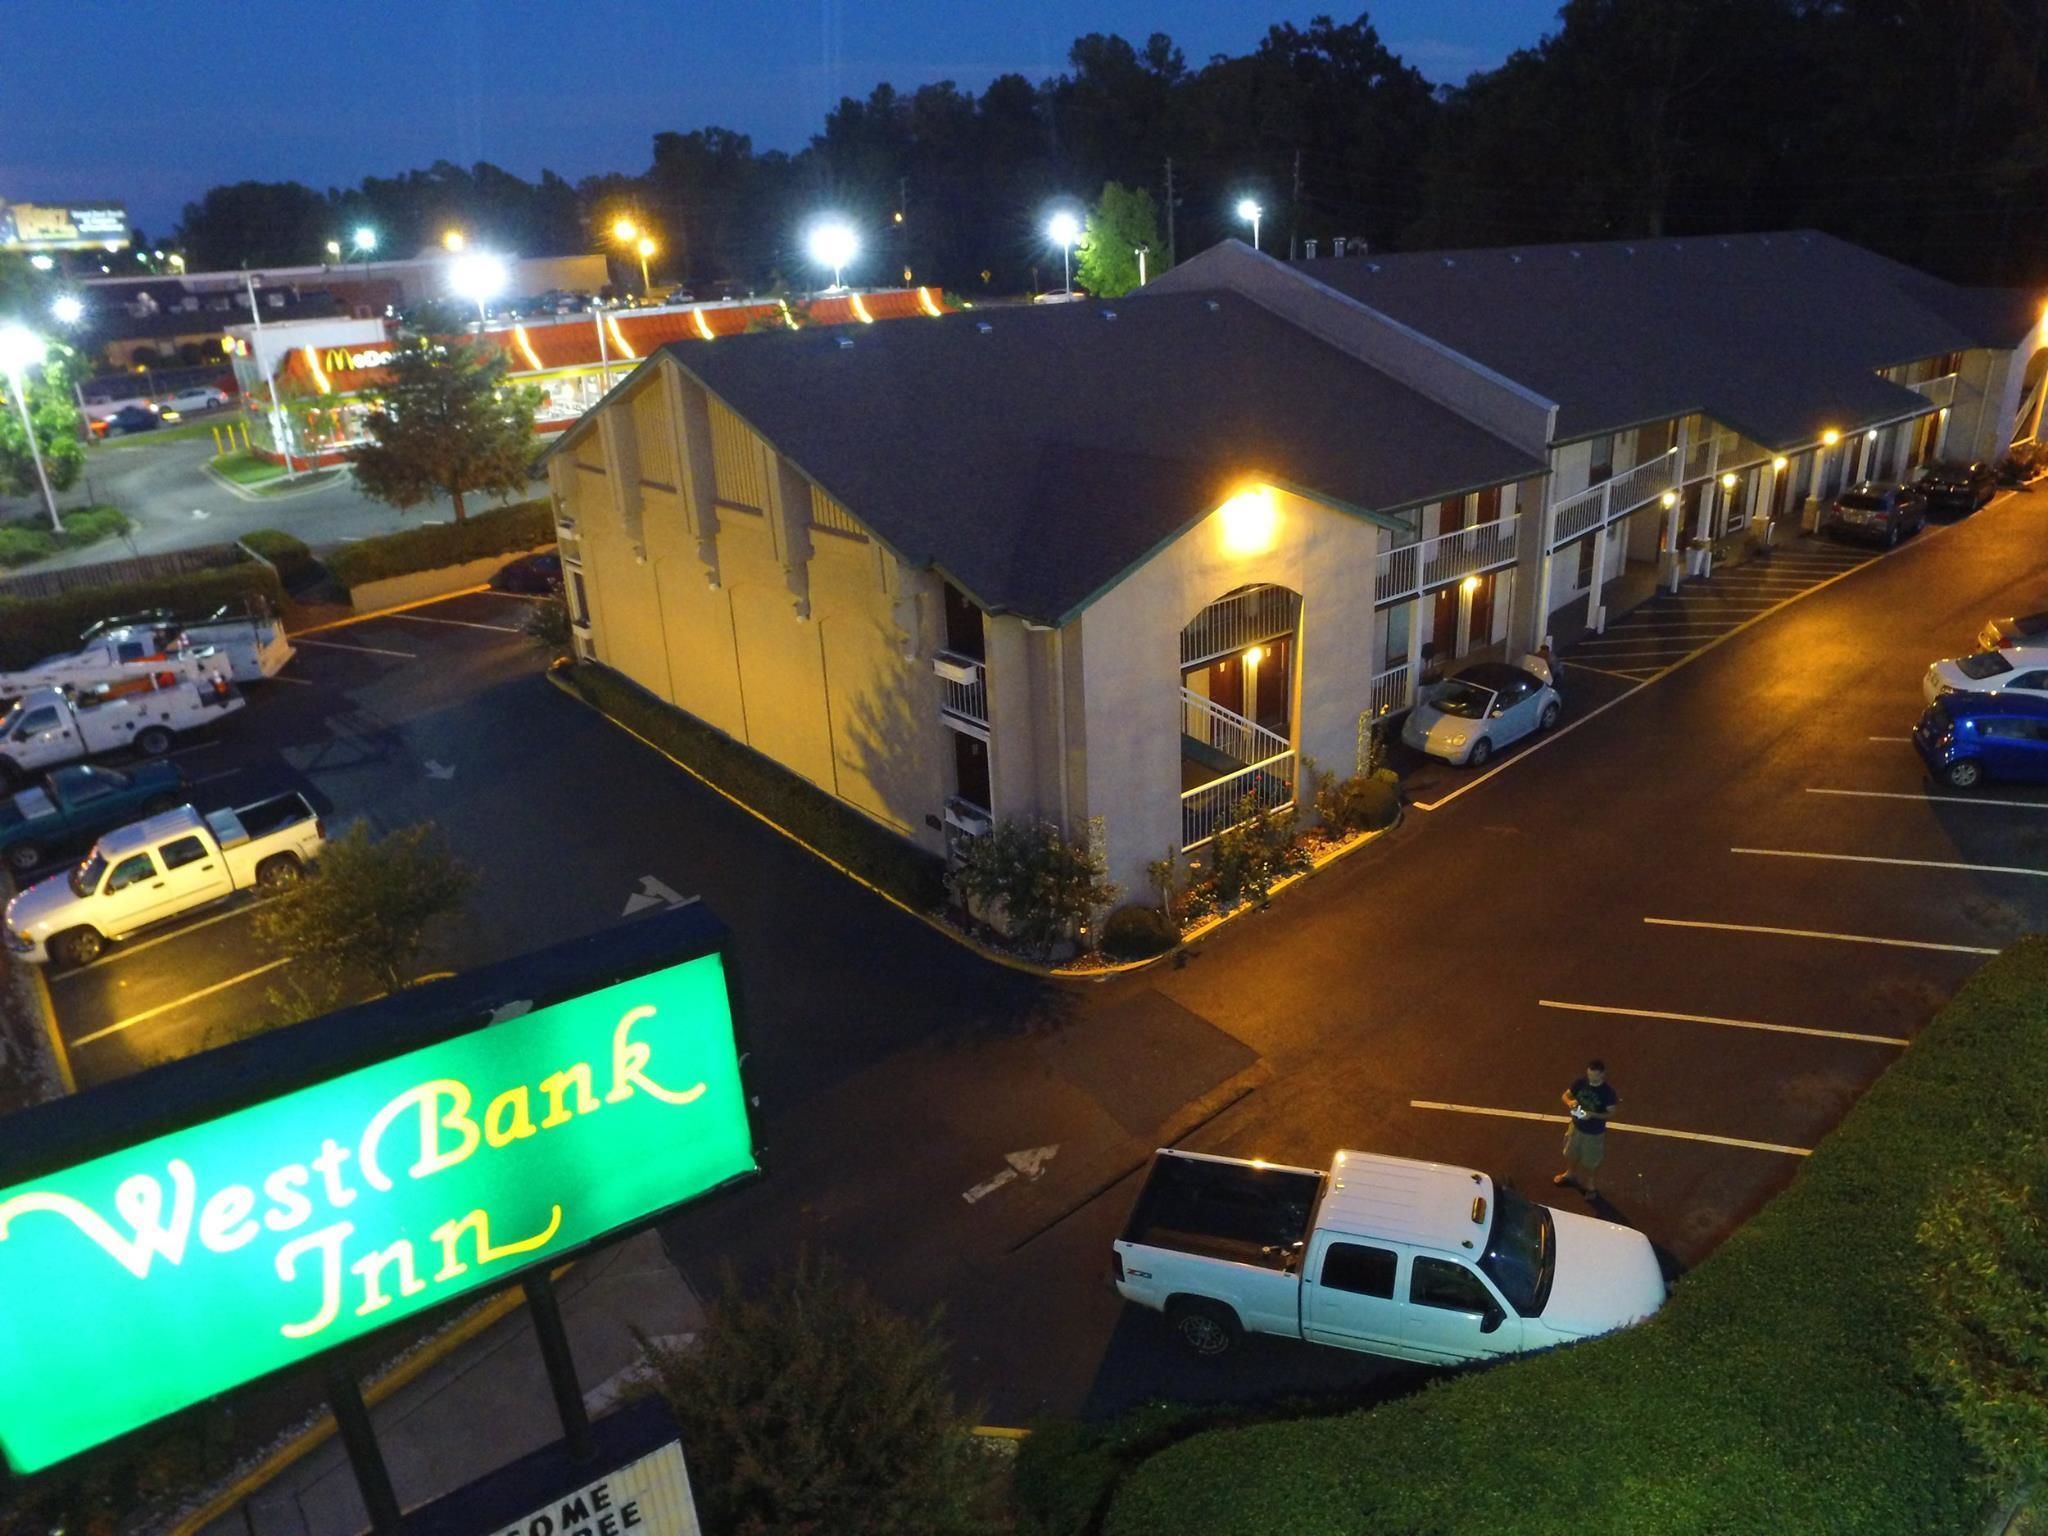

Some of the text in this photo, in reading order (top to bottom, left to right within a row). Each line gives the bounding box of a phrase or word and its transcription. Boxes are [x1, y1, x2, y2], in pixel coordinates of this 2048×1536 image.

[0, 1005, 706, 1280] West Bank
[275, 1205, 562, 1339] Inn
